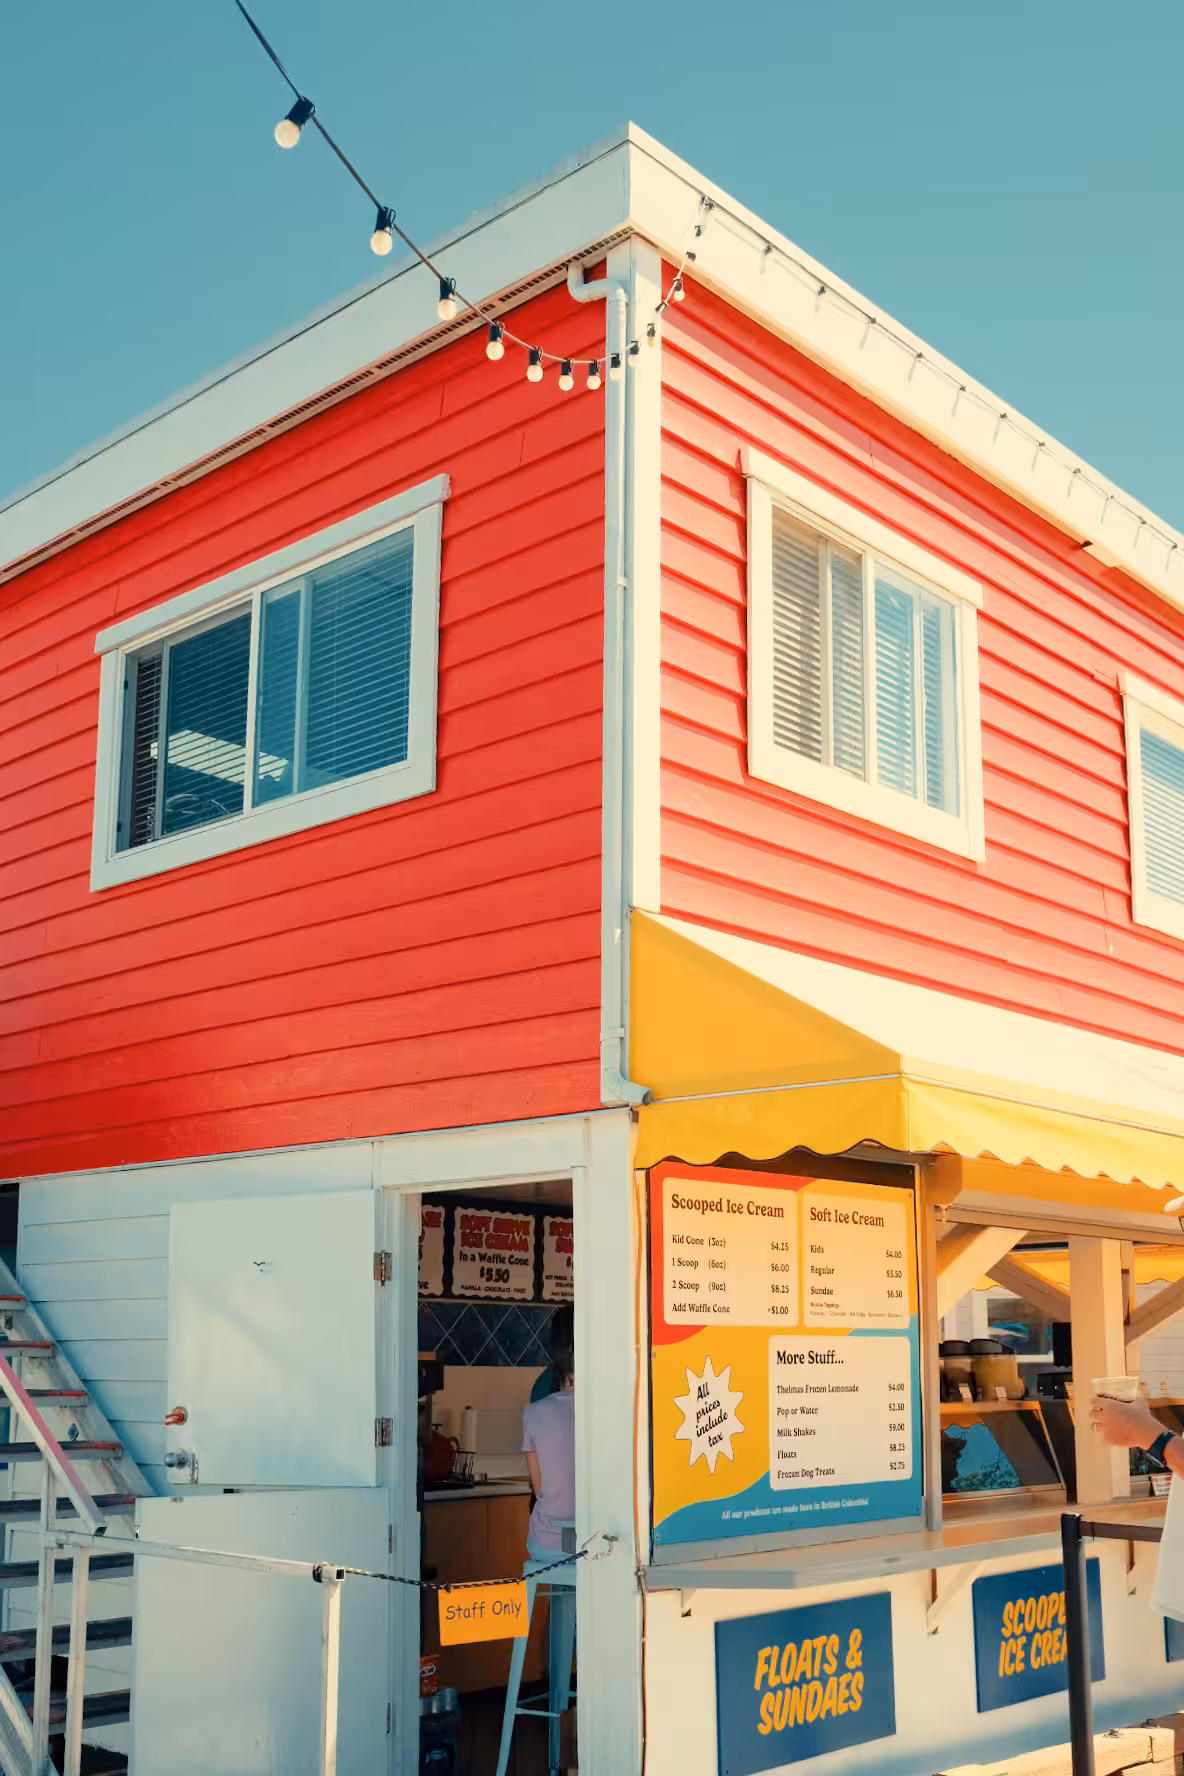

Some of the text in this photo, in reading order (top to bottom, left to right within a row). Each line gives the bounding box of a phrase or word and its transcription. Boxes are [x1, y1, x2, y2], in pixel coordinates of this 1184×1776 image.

[671, 1193, 784, 1218] Scooped Ice Cream
[810, 1207, 885, 1227] Soft Ice Cream
[672, 1234, 789, 1251] Kid Cone (3oz) $4.25
[459, 1250, 530, 1266] In a Waffle Cone
[810, 1244, 902, 1259] Kids $4.00
[677, 1258, 699, 1270] Scoop
[708, 1259, 726, 1270] (6oz)
[770, 1263, 790, 1272] $6.00
[810, 1265, 835, 1276] Regular
[672, 1280, 790, 1293] 2 Scoop (9oz) $8.25
[810, 1286, 903, 1298] Sundae $6.50
[672, 1303, 687, 1312] Add
[688, 1303, 711, 1313] Waffle
[712, 1304, 730, 1313] Cone
[776, 1350, 844, 1364] More Stuff...
[697, 1382, 710, 1402] All
[777, 1383, 905, 1394] Thelmas Frozen Lemonade $4.00
[696, 1399, 721, 1424] prices
[776, 1403, 905, 1418] Pop or Water $2.50
[695, 1408, 729, 1438] include
[777, 1423, 905, 1437] Milk Shakes $9.00
[708, 1432, 724, 1448] tax
[777, 1450, 797, 1459] Floats
[777, 1470, 800, 1479] Frozen
[801, 1468, 814, 1479] Dog
[815, 1467, 835, 1476] Treats
[721, 1510, 731, 1519] All
[731, 1511, 743, 1519] our
[446, 1599, 522, 1620] Staff Only
[754, 1628, 863, 1691] FLOATS &
[999, 1635, 1026, 1677] ICE
[757, 1671, 865, 1736] SUNDAES
